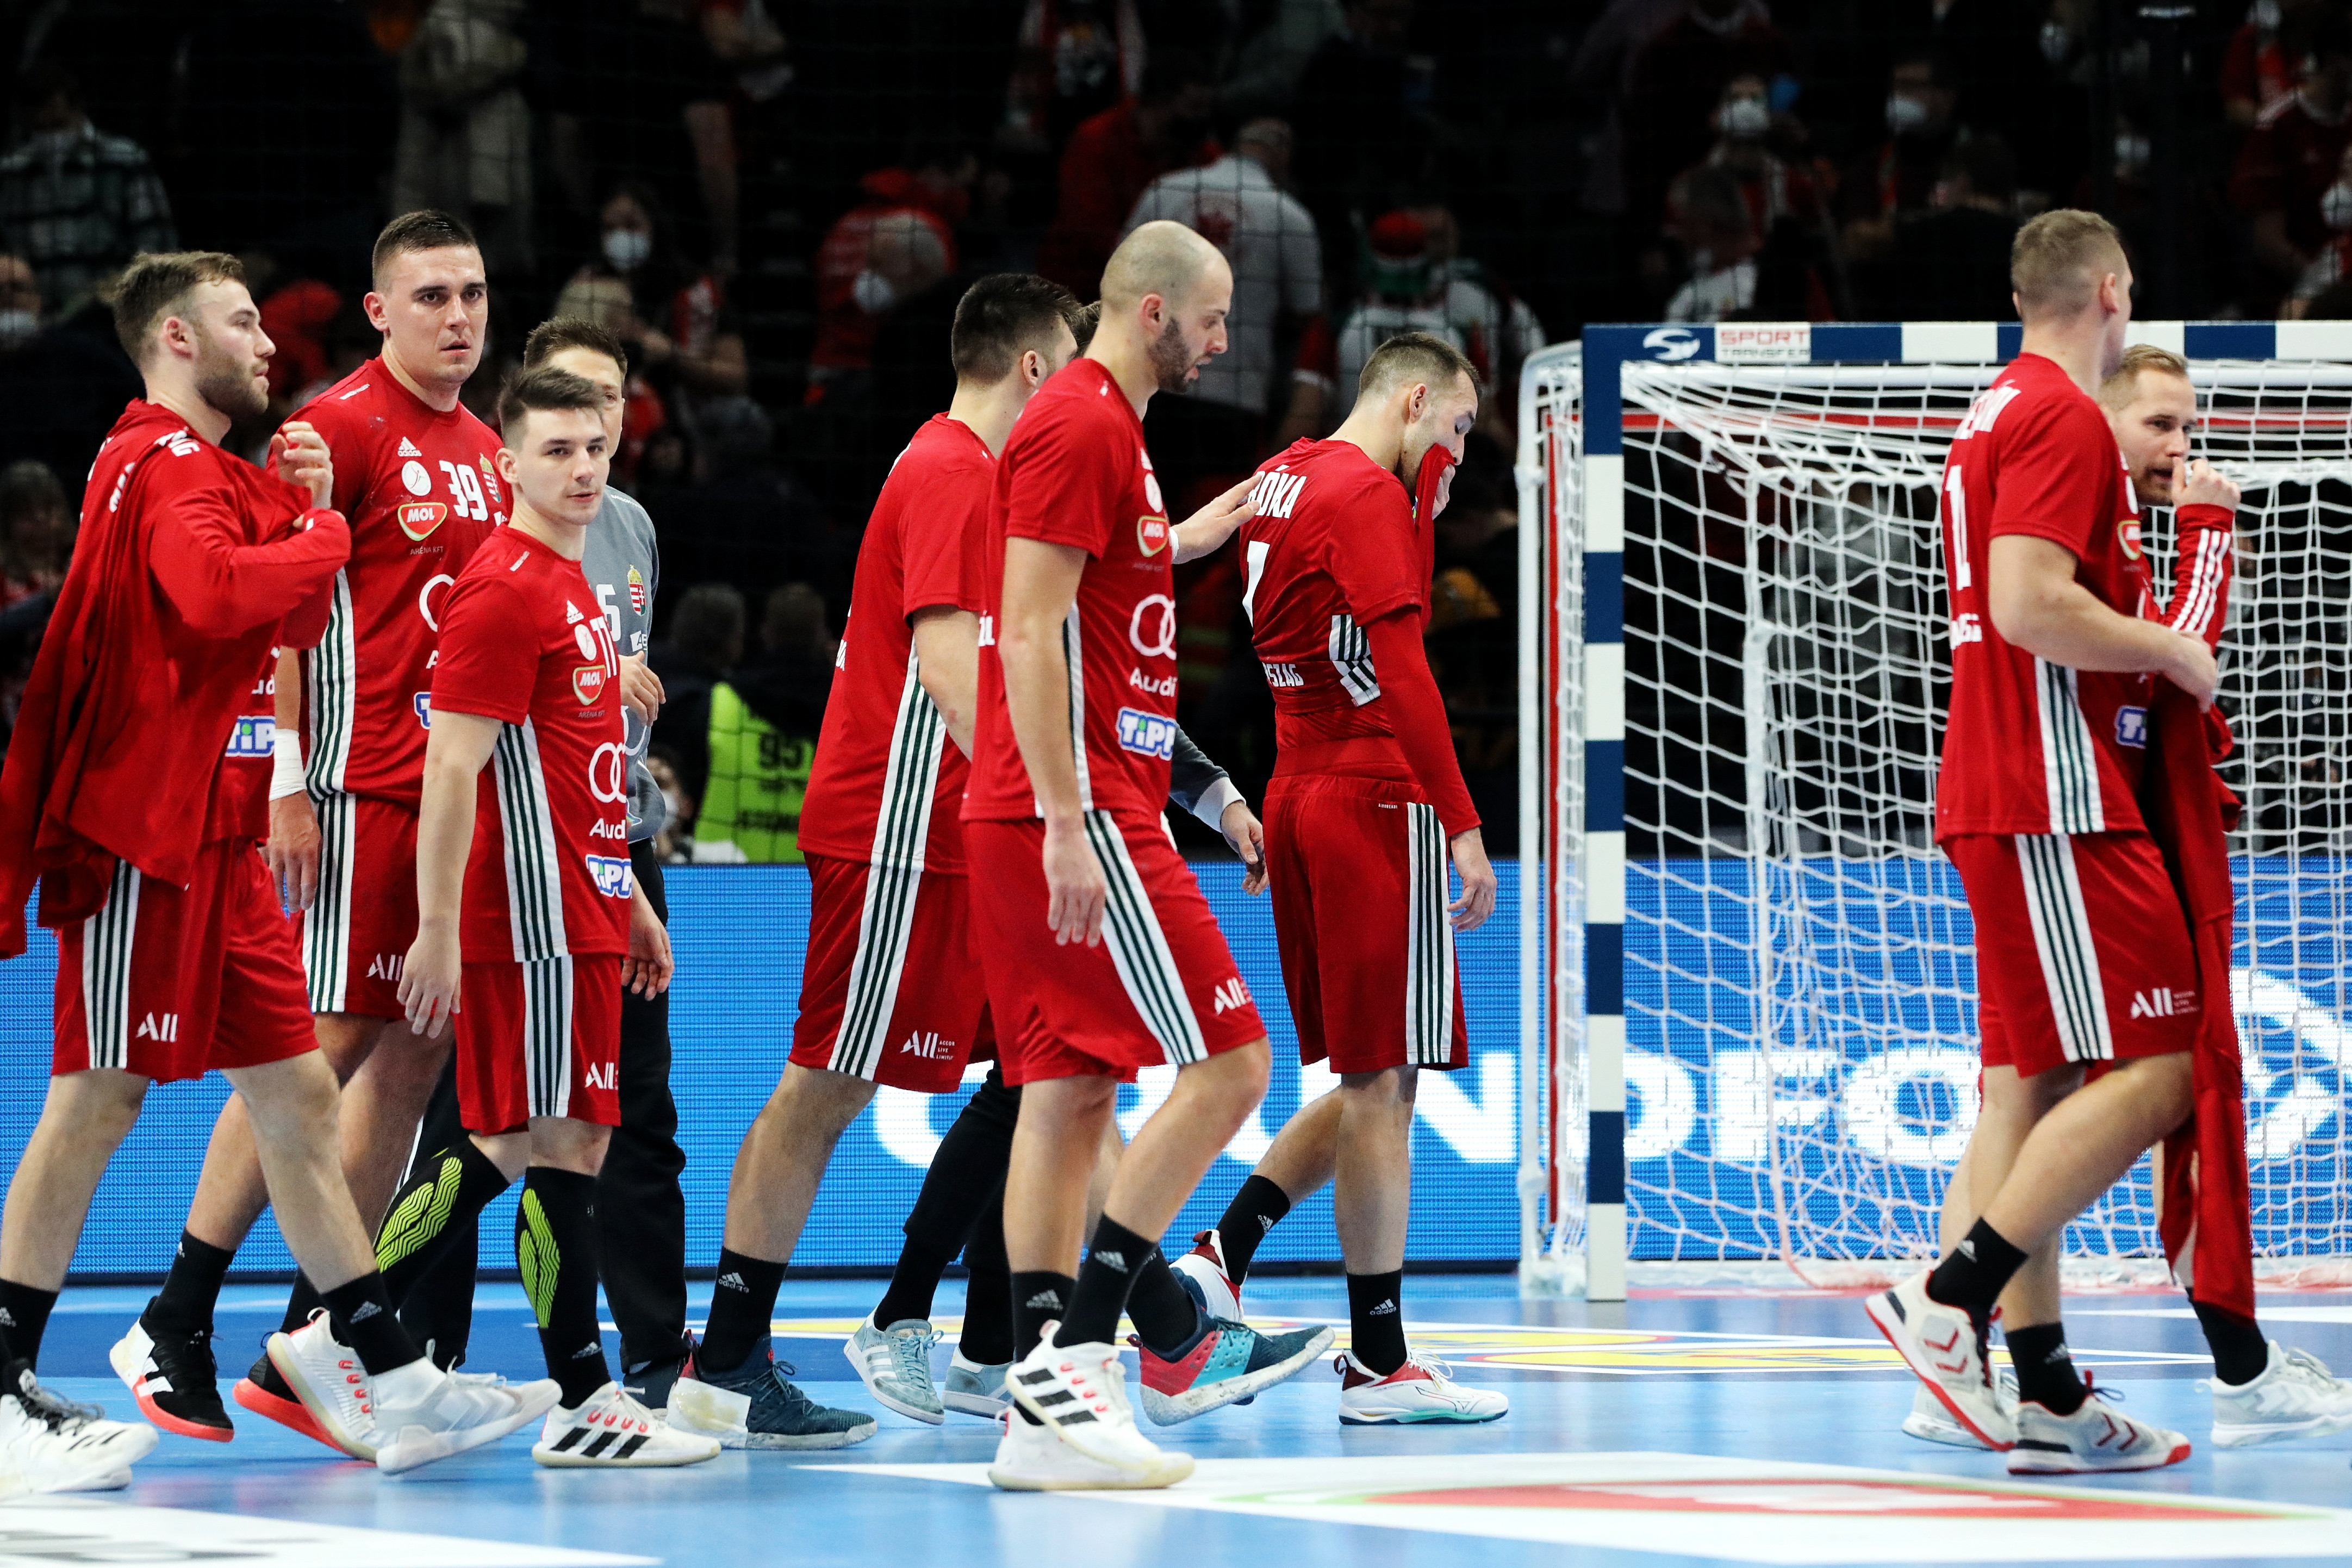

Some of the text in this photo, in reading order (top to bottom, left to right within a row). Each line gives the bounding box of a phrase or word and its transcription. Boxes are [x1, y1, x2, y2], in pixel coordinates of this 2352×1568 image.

[1721, 330, 1809, 345] SPORT
[439, 460, 488, 521] 39
[407, 507, 435, 522] MOL
[1242, 540, 1270, 628] 7
[1129, 667, 1178, 697] Audi
[589, 818, 626, 839] Aud
